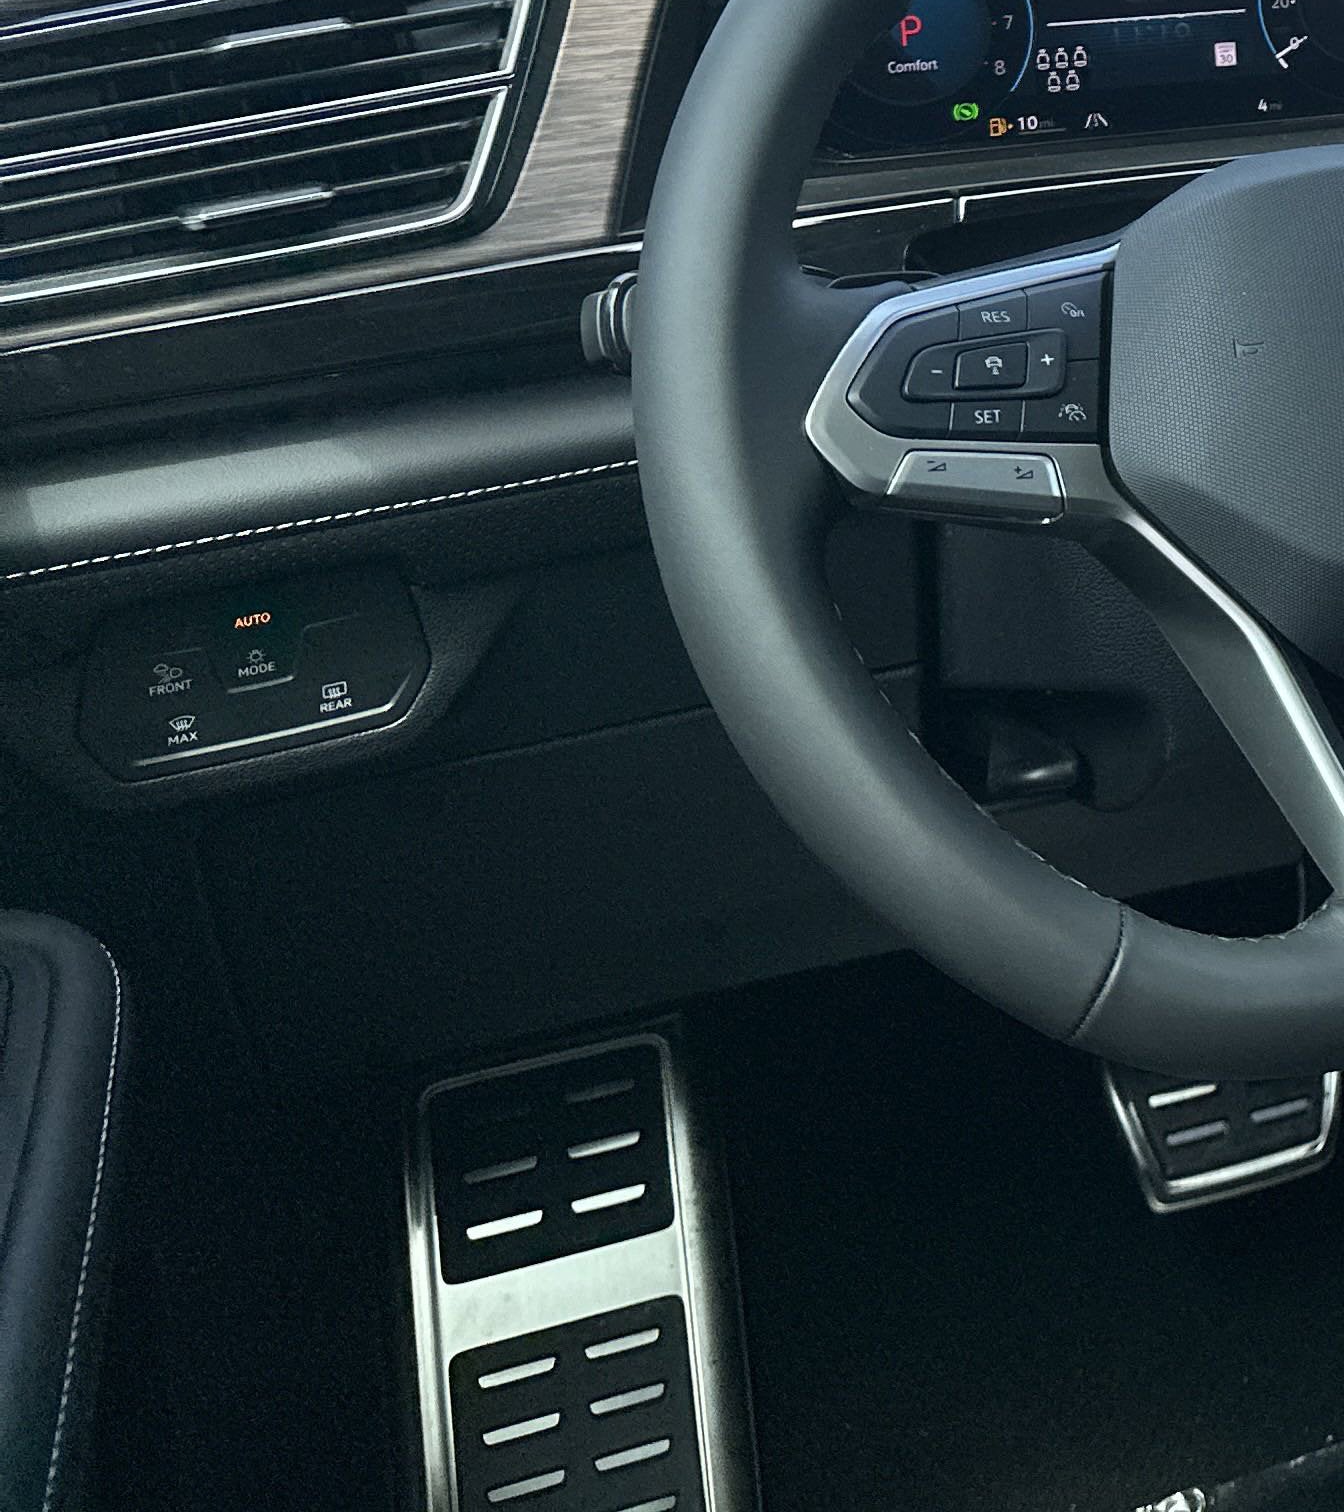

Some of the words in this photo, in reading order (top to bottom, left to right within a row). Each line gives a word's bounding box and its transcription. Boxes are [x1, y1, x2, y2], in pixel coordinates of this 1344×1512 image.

[1002, 14, 1014, 30] 7
[899, 14, 922, 47] P
[887, 59, 939, 74] Comfort
[994, 60, 1006, 76] 8
[1017, 115, 1039, 131] 10
[980, 311, 1011, 324] RES
[974, 409, 1001, 424] SET
[234, 611, 271, 629] AUTO
[238, 661, 276, 678] MODE
[148, 679, 193, 697] FRONT
[319, 698, 352, 713] REAR
[167, 731, 198, 747] MAX
